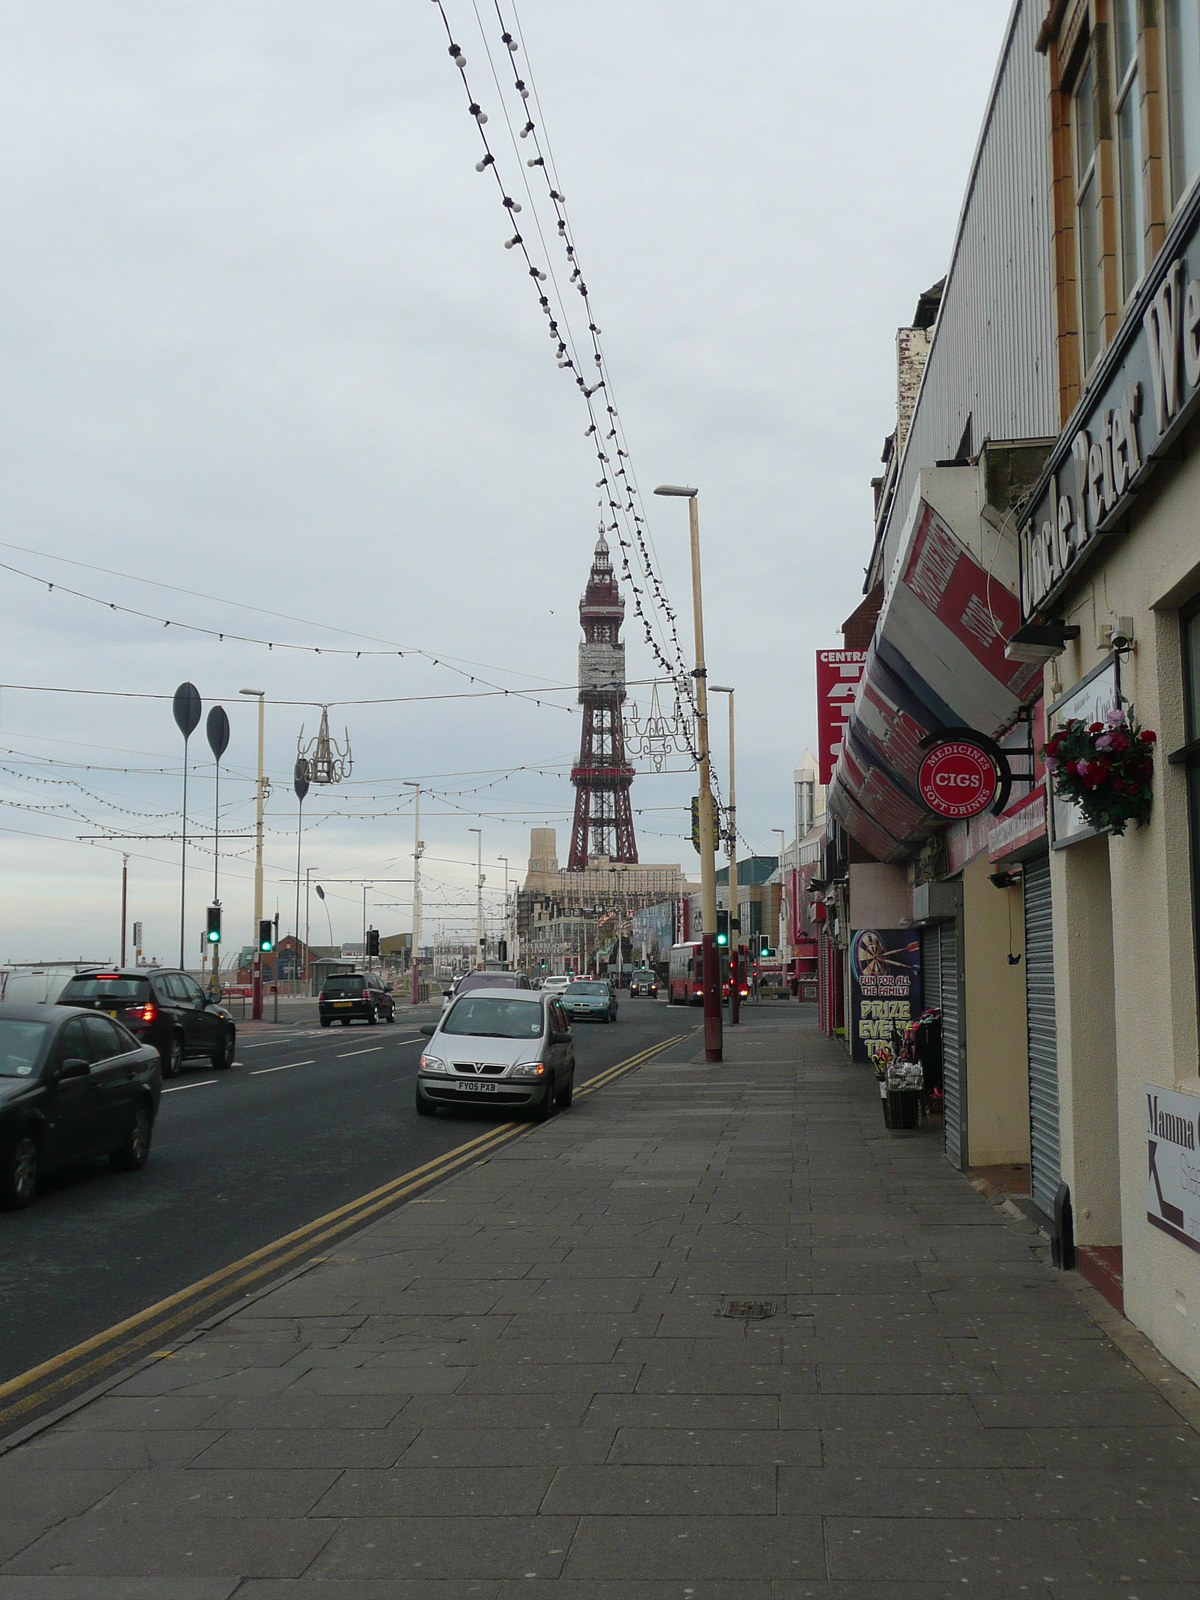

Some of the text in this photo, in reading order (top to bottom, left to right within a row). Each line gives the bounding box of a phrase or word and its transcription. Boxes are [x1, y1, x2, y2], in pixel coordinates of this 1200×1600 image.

[1021, 475, 1072, 619] Uncle
[1072, 381, 1142, 551] Peter
[960, 593, 1004, 648] STORE
[820, 651, 868, 662] CENTRA
[927, 745, 990, 770] MEDICINES
[935, 773, 980, 787] CIGS
[924, 785, 990, 814] SOFT DRINKS
[860, 975, 910, 985] FUN FOR ALL
[861, 986, 909, 996] THE FAMILY!
[861, 1000, 911, 1019] PRIZE
[480, 1083, 495, 1091] PXB
[1146, 1093, 1195, 1151] Mamma
